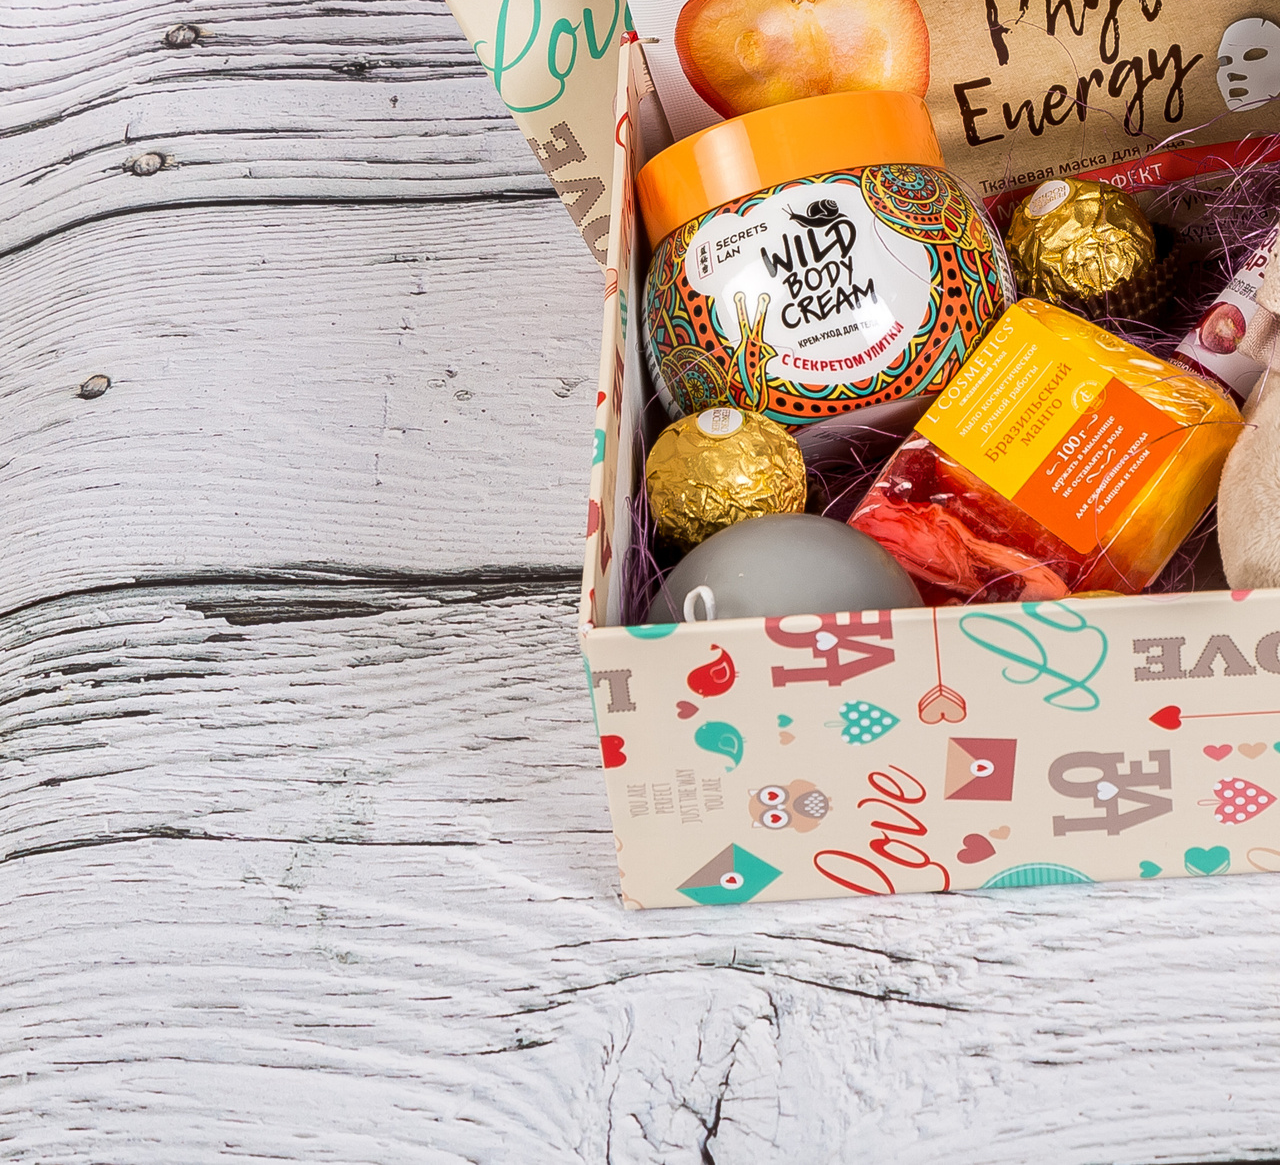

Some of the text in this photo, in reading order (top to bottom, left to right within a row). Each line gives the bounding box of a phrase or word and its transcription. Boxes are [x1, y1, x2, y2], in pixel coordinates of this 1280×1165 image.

[953, 43, 1204, 146] Energy
[979, 166, 1054, 195] Тканевая
[1059, 153, 1106, 174] маска
[1111, 145, 1140, 163] для
[716, 222, 768, 252] SECRETS
[717, 246, 741, 264] LAN
[760, 217, 857, 277] WILD
[781, 278, 879, 330] CREAM
[782, 256, 854, 300] BODY
[793, 352, 866, 372] СЕКРЕТОМ
[864, 320, 905, 362] УЛИТКИ
[798, 328, 843, 349] КРЕМ-УХОД
[843, 323, 860, 335] ДЛЯ
[959, 410, 982, 437] мыло
[981, 343, 1038, 412] косметическое
[980, 366, 1039, 434] ручной работы
[984, 362, 1072, 463] Бразильский
[1021, 398, 1063, 447] манго
[1056, 435, 1081, 462] 100
[1051, 459, 1079, 494] держать
[1082, 415, 1115, 456] мыльнице
[1062, 486, 1073, 498] не
[1071, 449, 1104, 488] оставлять
[1108, 425, 1124, 445] воде
[1075, 503, 1089, 520] для
[1128, 432, 1149, 455] ухода
[1103, 481, 1125, 505] лицом
[1129, 450, 1150, 476] телом
[627, 783, 649, 818] YOU ARE
[652, 783, 675, 814] PERFECT
[675, 769, 703, 824] JUST THE WAY
[702, 777, 724, 812] YOU ARE
